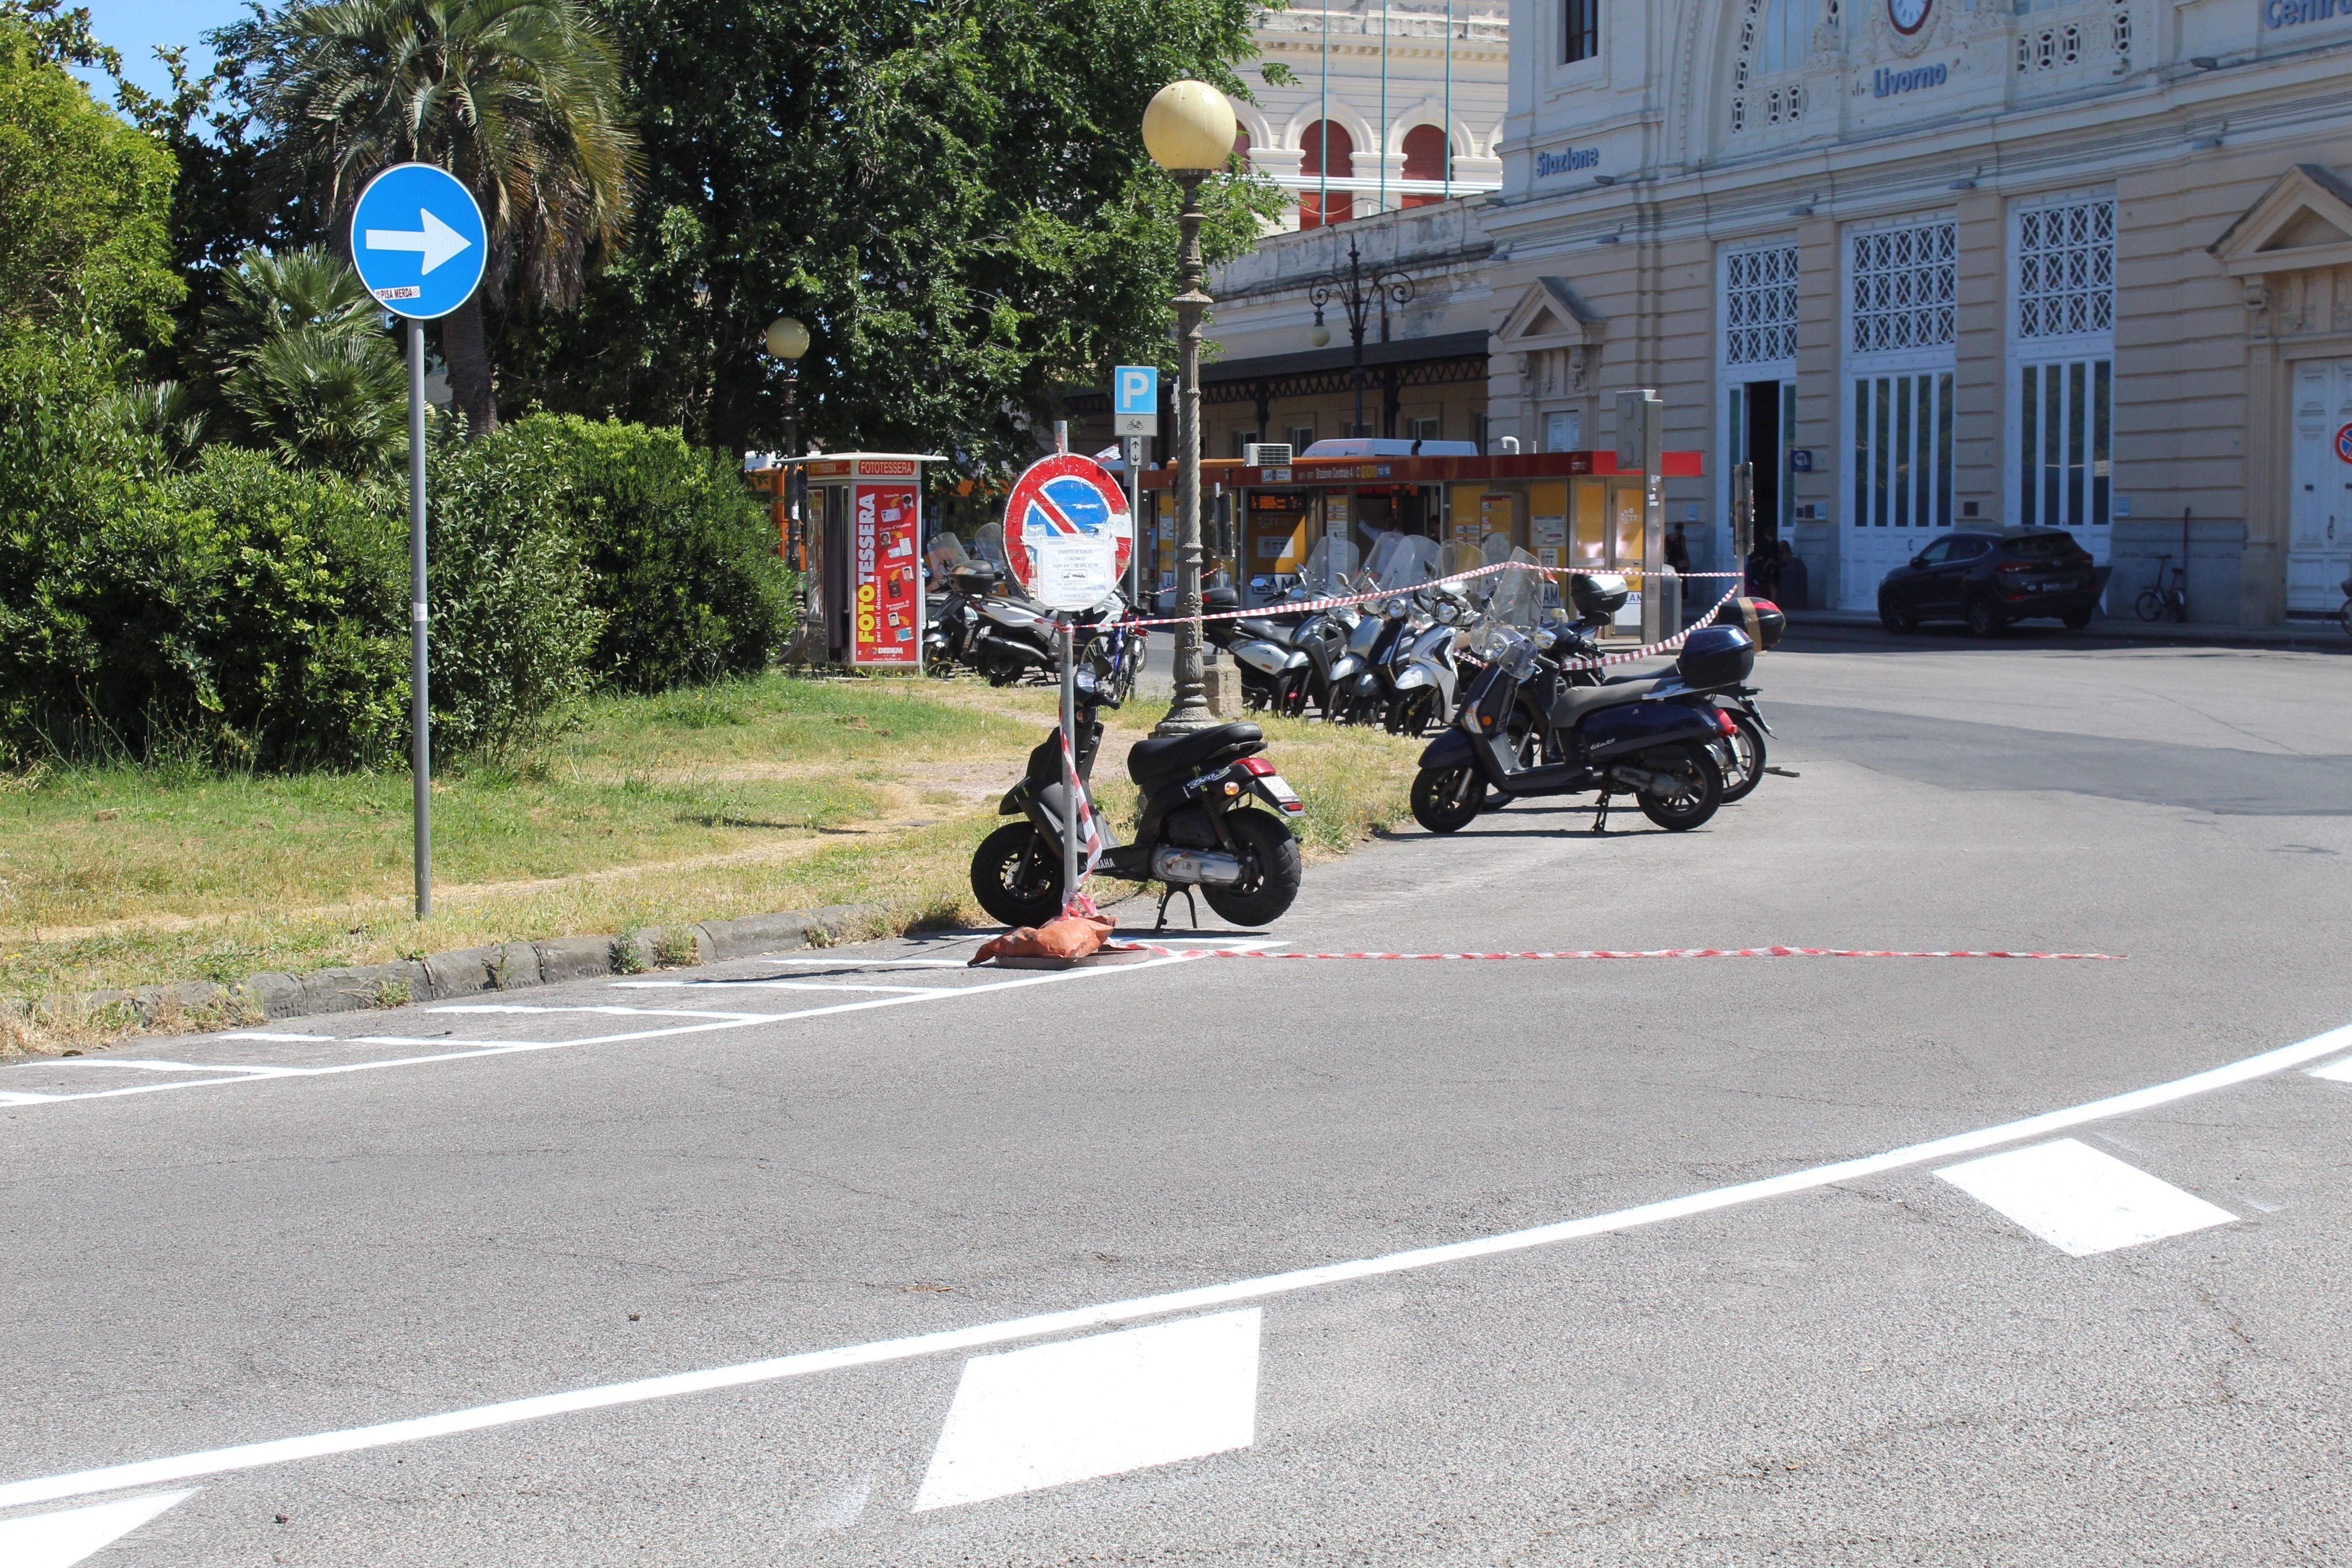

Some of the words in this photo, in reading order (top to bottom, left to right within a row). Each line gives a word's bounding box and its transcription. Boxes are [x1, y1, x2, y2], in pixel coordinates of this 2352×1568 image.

[1874, 63, 1947, 98] Livorno
[1536, 147, 1599, 177] Stazione
[381, 289, 393, 299] PISA
[394, 288, 412, 298] MERDA
[1123, 372, 1149, 408] P
[861, 461, 911, 474] FOTOTESSERA
[858, 493, 875, 642] FOTOTESSERA
[884, 561, 906, 569] Passaporto
